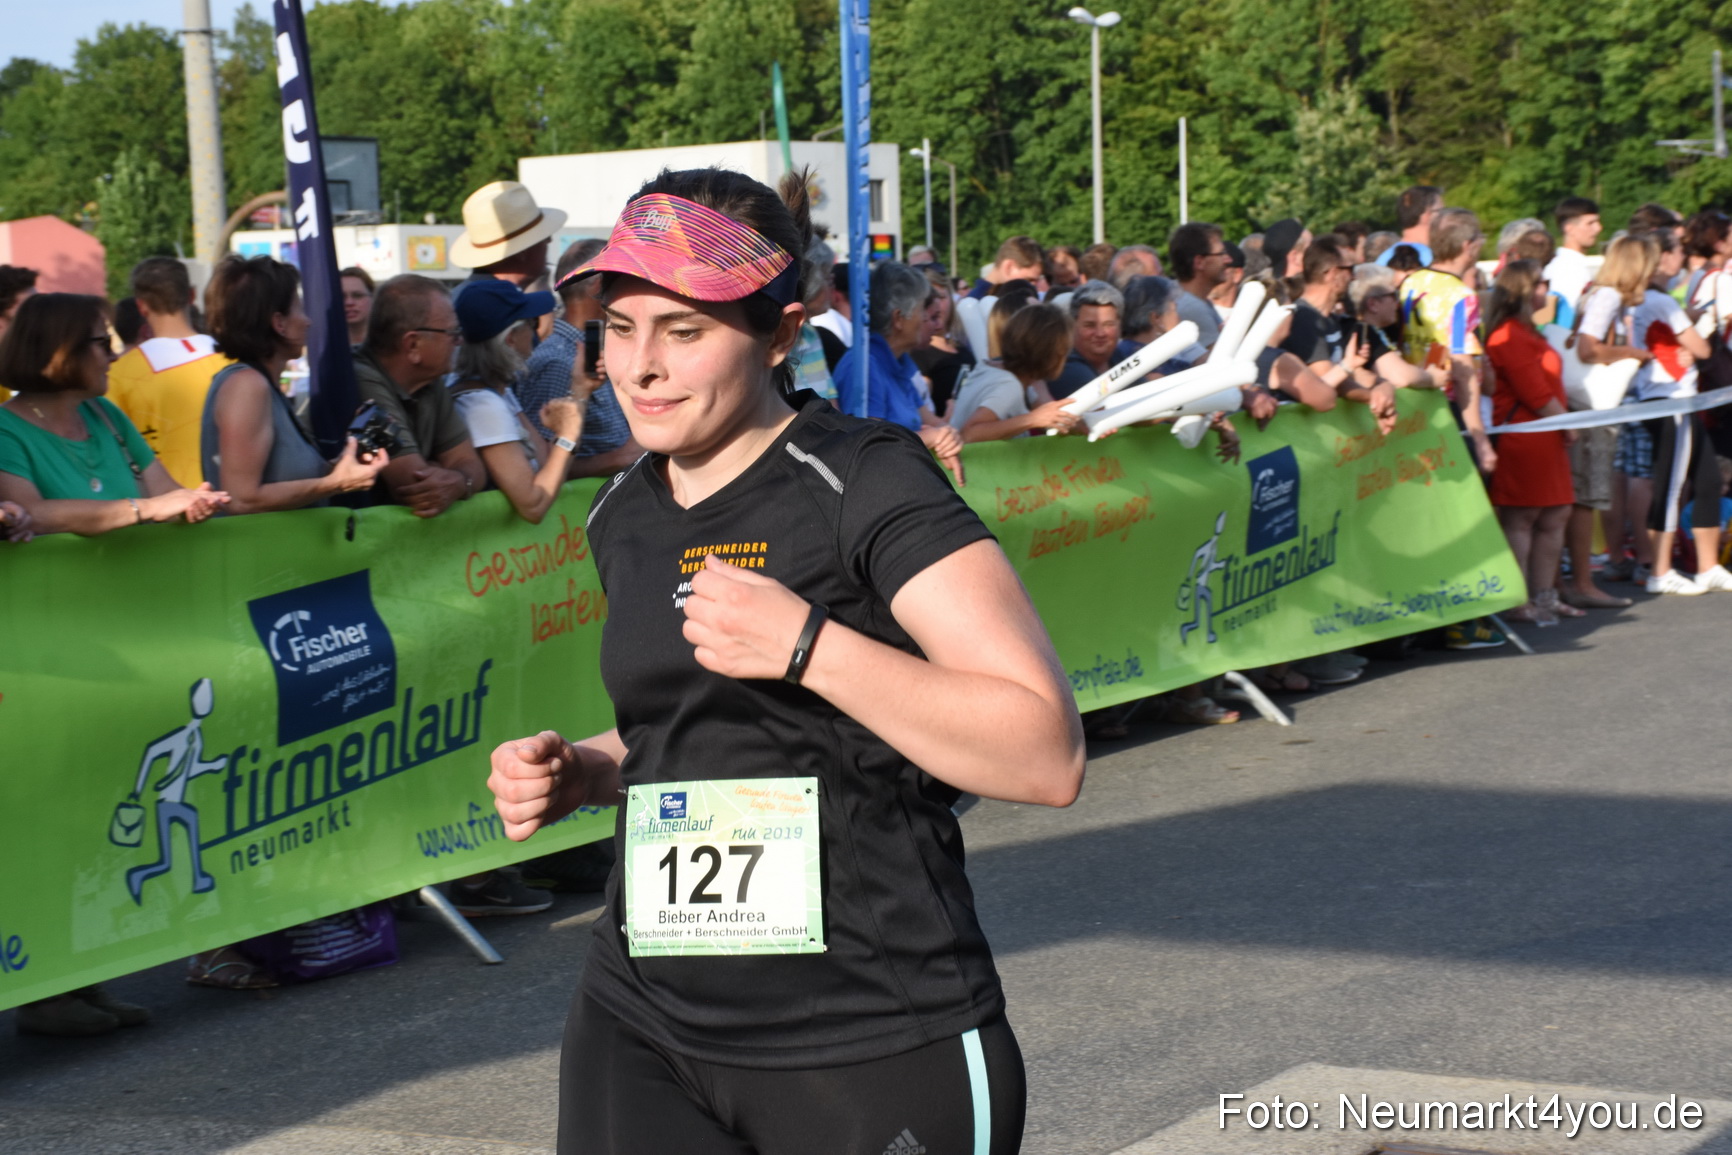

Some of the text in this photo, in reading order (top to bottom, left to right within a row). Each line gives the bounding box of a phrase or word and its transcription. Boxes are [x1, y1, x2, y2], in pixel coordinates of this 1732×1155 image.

[465, 513, 589, 598] Gesunde
[684, 541, 768, 560] BERSCHNEIDER
[1221, 509, 1342, 611] firmenlauf
[288, 622, 368, 663] Fischer
[223, 658, 493, 840] firmenlauf
[231, 799, 352, 874] neumarkt
[648, 814, 715, 834] firmenlauf
[763, 825, 803, 840] 2019
[659, 844, 764, 905] 127
[633, 929, 683, 939] Berschneider
[695, 927, 768, 937] Berschneider
[771, 926, 808, 936] GmbH
[658, 909, 766, 924] Bieber Andrea
